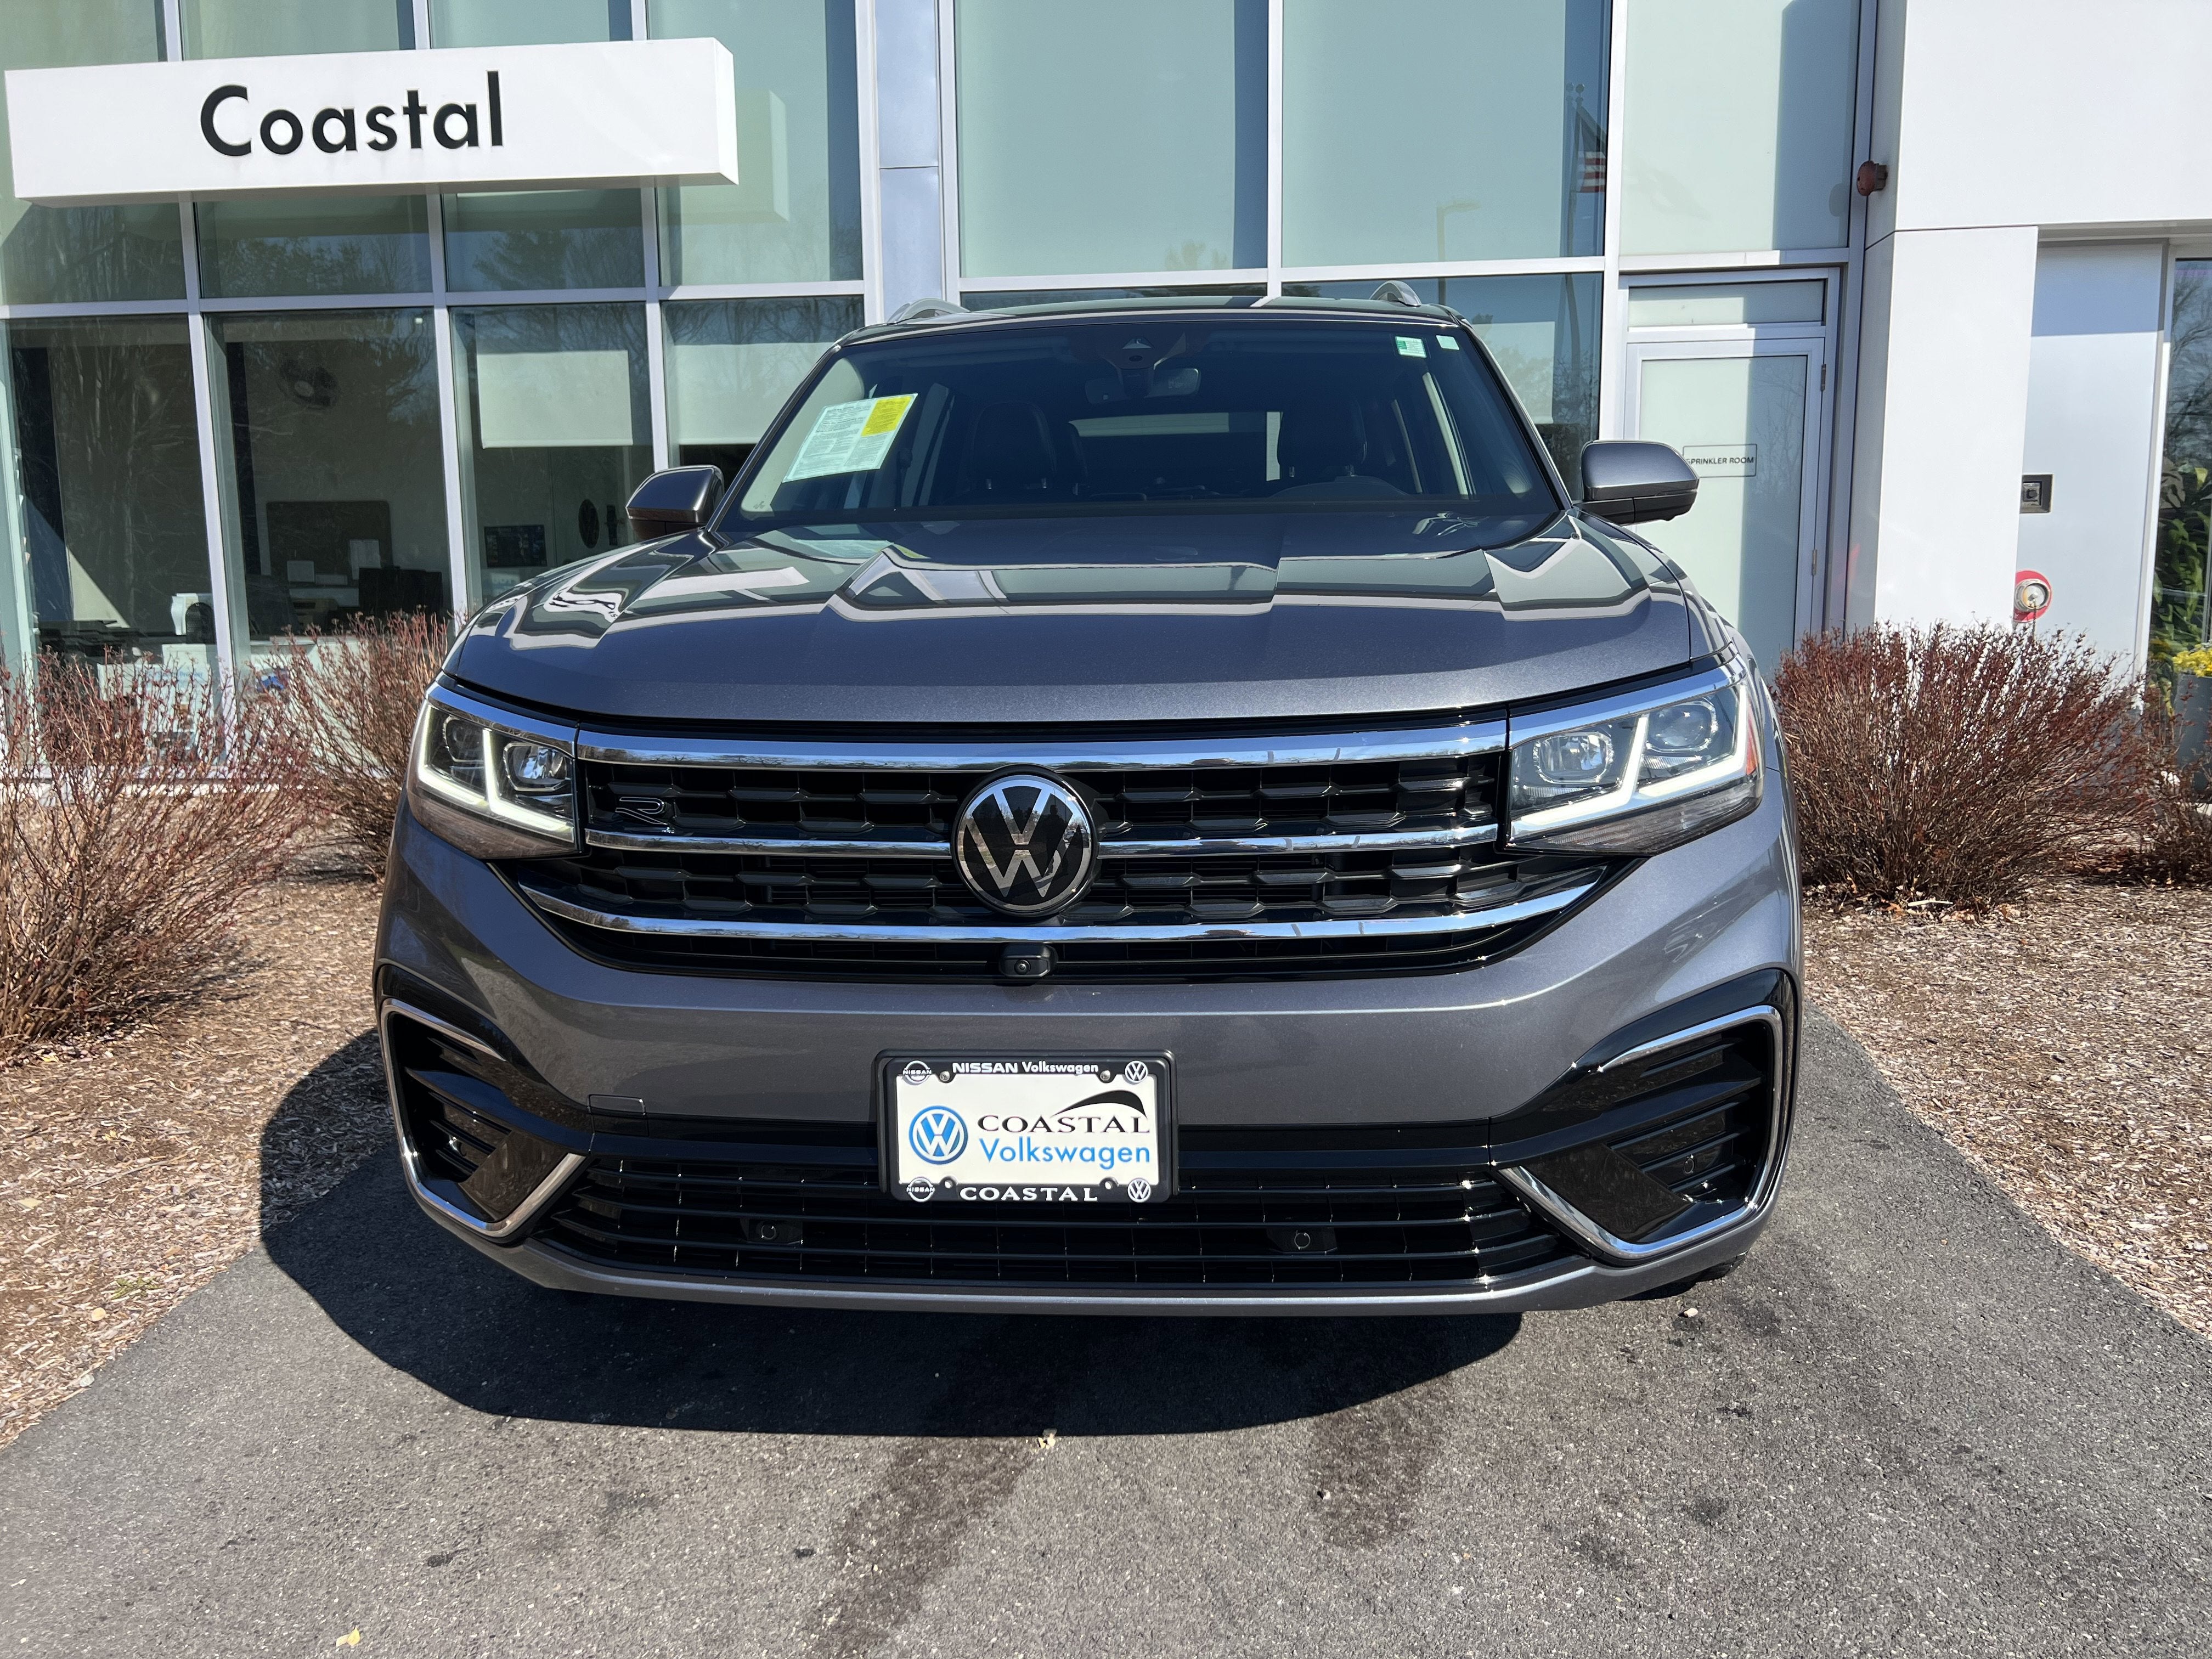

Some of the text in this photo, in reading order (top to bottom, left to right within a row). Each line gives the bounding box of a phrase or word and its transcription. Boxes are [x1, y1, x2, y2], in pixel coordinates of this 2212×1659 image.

[200, 70, 504, 157] Coastal
[952, 1061, 1098, 1075] NISSAN Volkswagen
[977, 1114, 1150, 1133] COASTAL
[979, 1136, 1150, 1170] Volkswagen
[960, 1186, 1098, 1201] COASTAL
